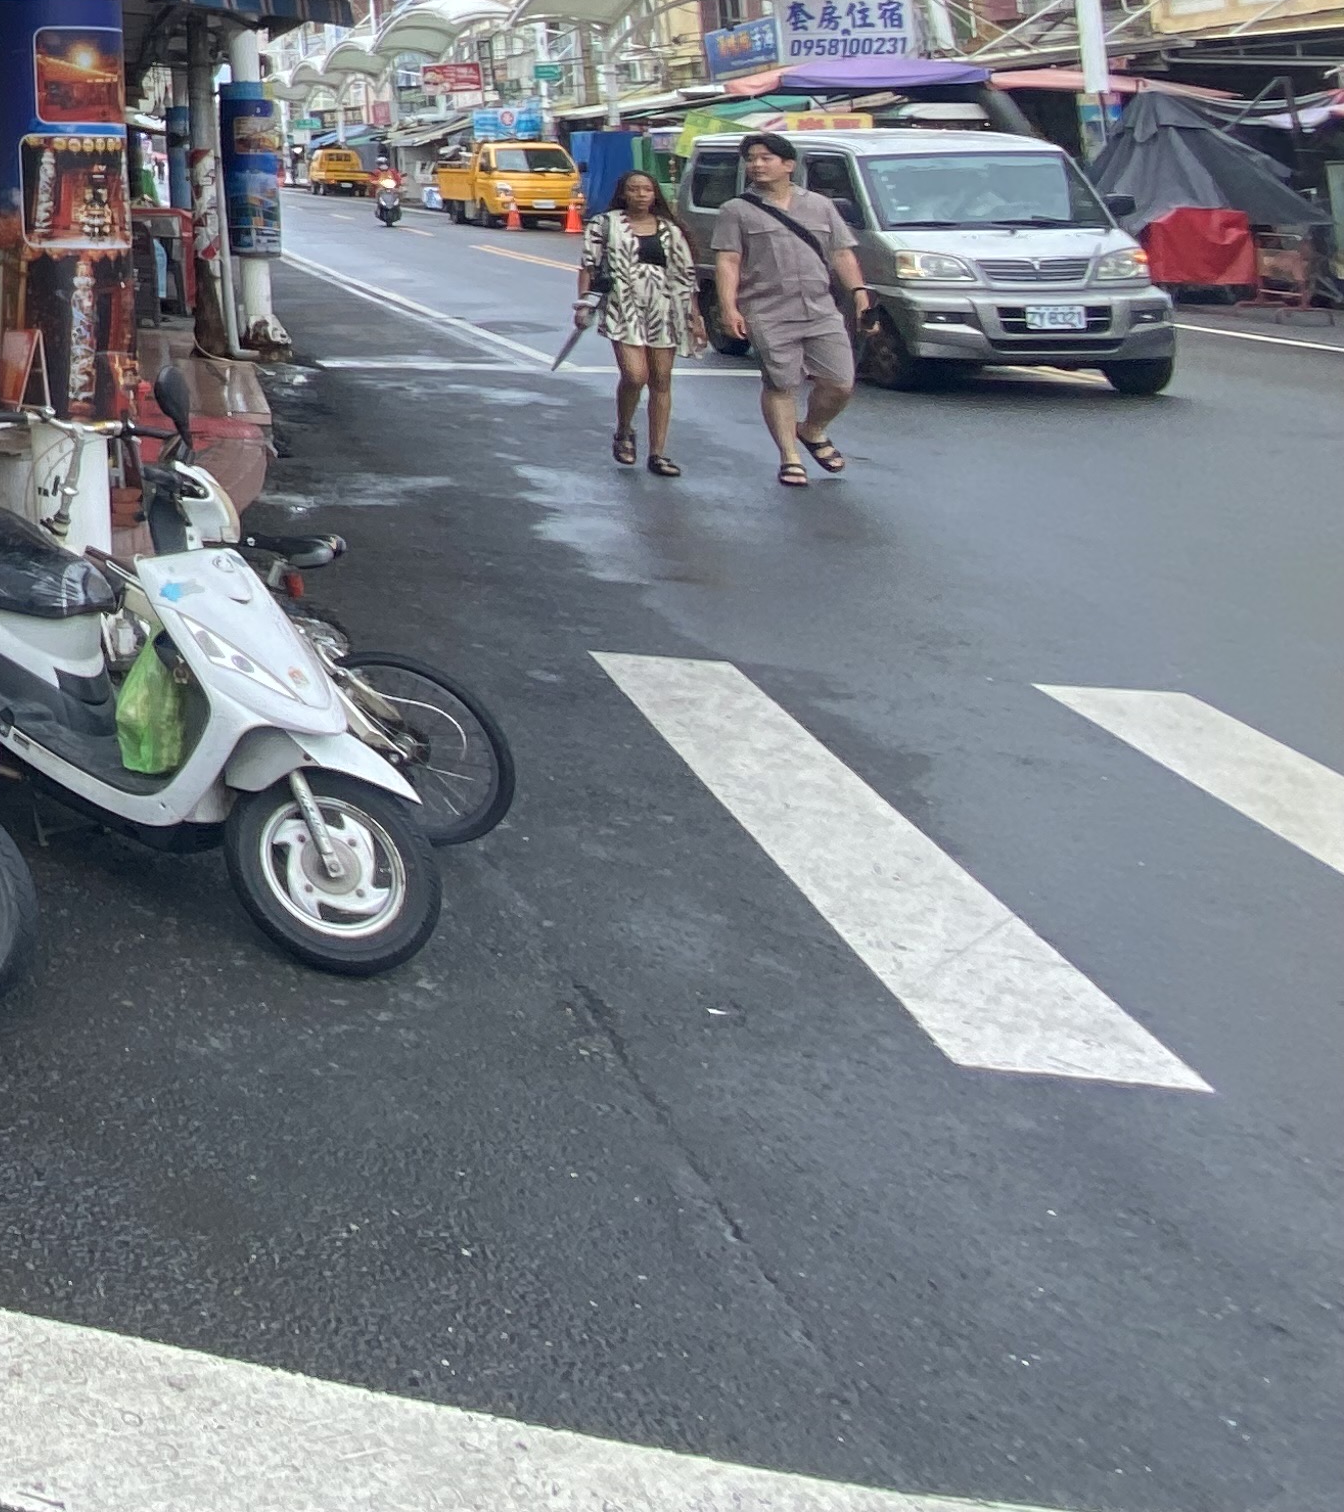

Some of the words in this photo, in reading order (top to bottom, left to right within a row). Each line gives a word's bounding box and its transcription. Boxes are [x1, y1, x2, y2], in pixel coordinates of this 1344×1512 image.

[786, 0, 904, 32] 套房住宿
[790, 37, 908, 57] 0958100231
